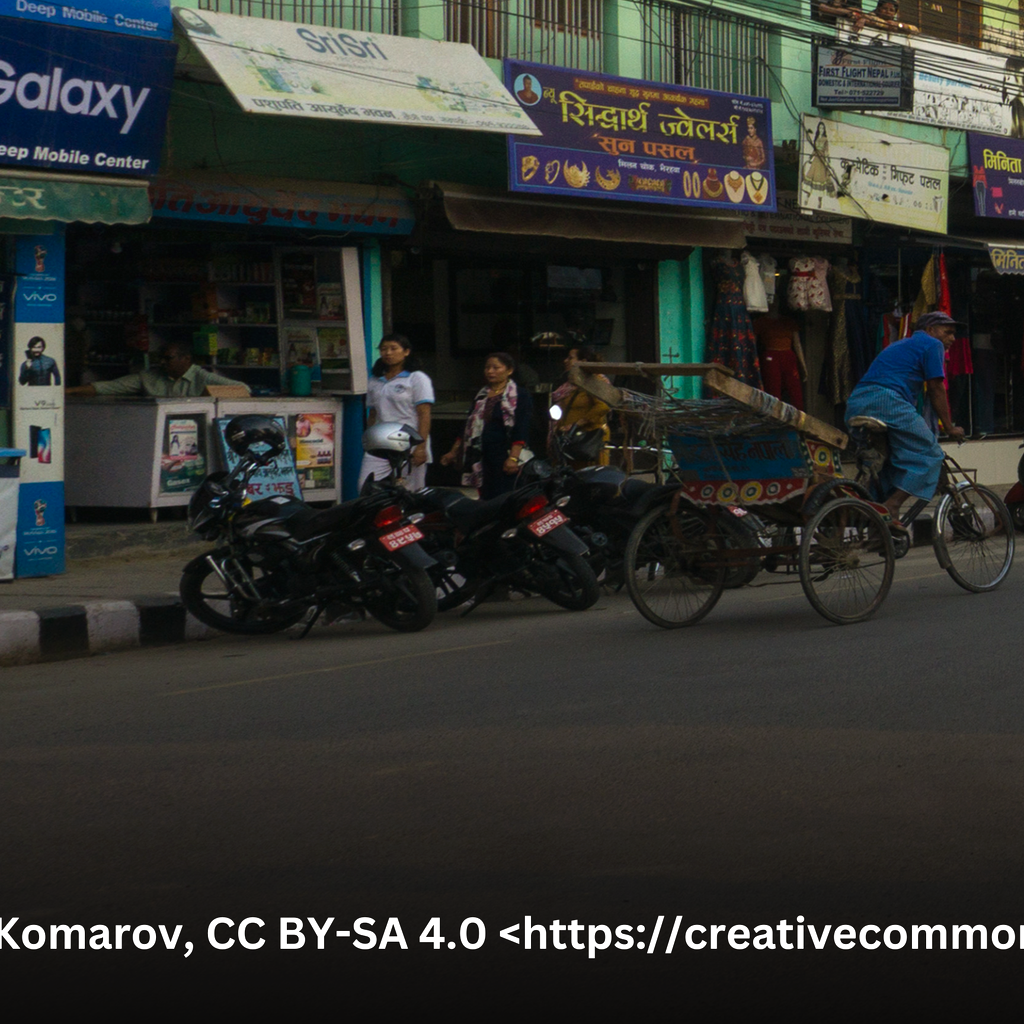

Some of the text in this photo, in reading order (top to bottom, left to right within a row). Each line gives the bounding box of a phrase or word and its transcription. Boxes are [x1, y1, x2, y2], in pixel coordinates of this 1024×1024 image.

[62, 6, 108, 24] Mobile
[114, 13, 159, 32] Center
[819, 66, 839, 77] FIRST
[841, 66, 866, 78] FLIGHT
[867, 67, 889, 78] NEPAL
[251, 98, 304, 111] पशुपति
[361, 107, 397, 119] भवन
[657, 107, 740, 144] ज्वेलर्स
[33, 146, 90, 164] Mobile
[94, 153, 149, 169] Center
[599, 136, 695, 160] सुन पसल
[983, 149, 1022, 173] मिनिता
[919, 175, 941, 190] पसल
